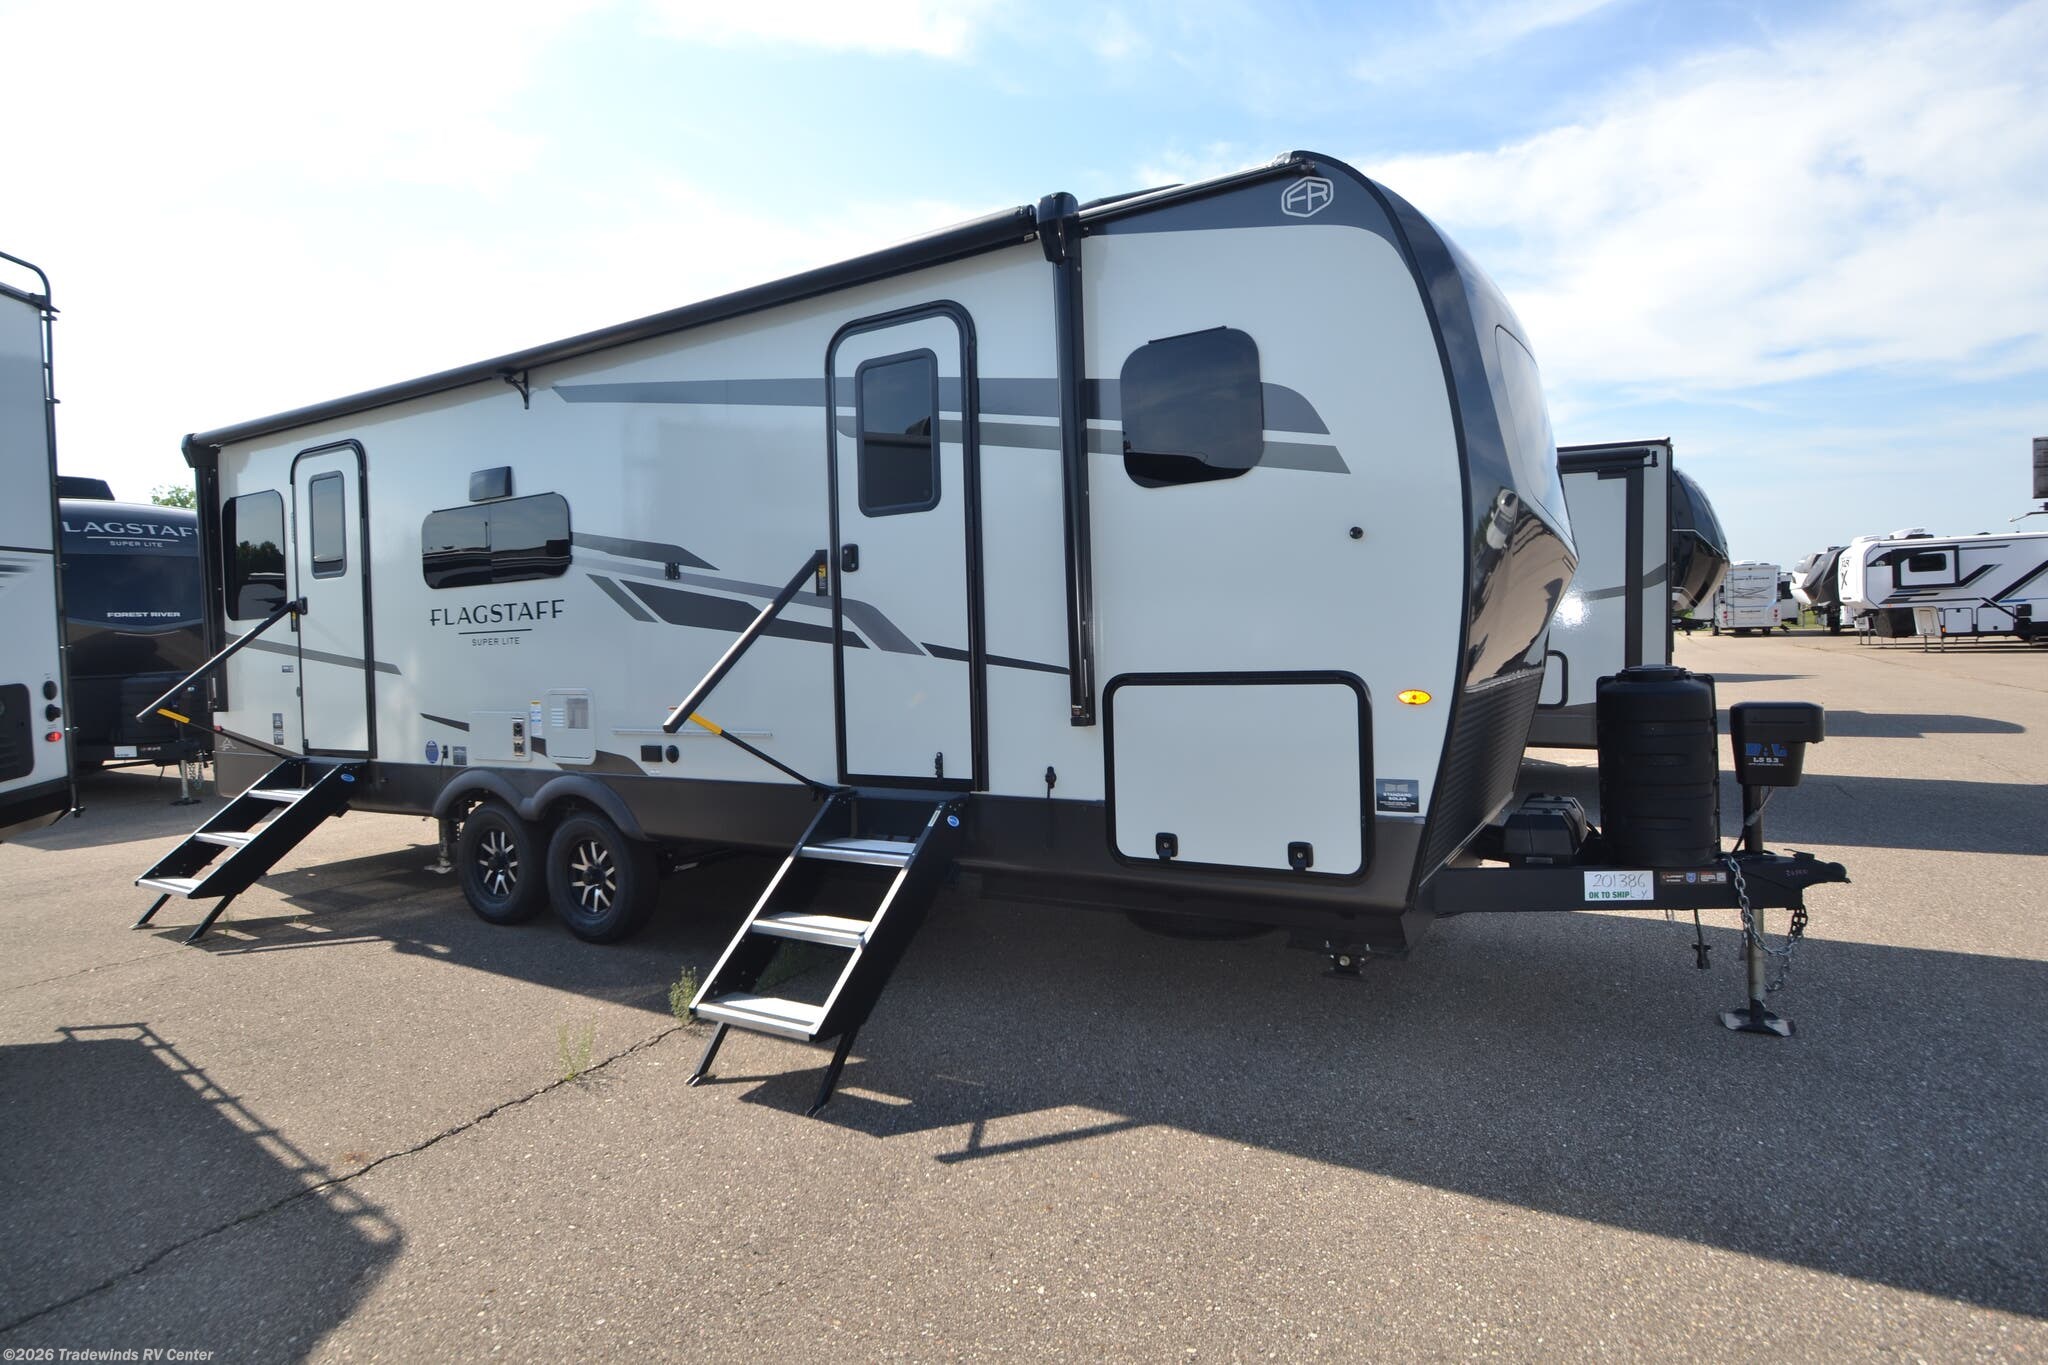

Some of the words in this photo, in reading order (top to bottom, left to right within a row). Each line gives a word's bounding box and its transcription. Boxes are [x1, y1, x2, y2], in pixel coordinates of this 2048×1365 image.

[62, 521, 199, 537] LAGSTAF
[430, 599, 565, 626] FLAGSTAFF
[471, 638, 500, 647] SUPER
[502, 636, 521, 646] LITE
[1592, 873, 1647, 888] 201386
[1588, 891, 1599, 899] OK
[1601, 891, 1610, 899] TO
[1612, 891, 1630, 899] SHIP
